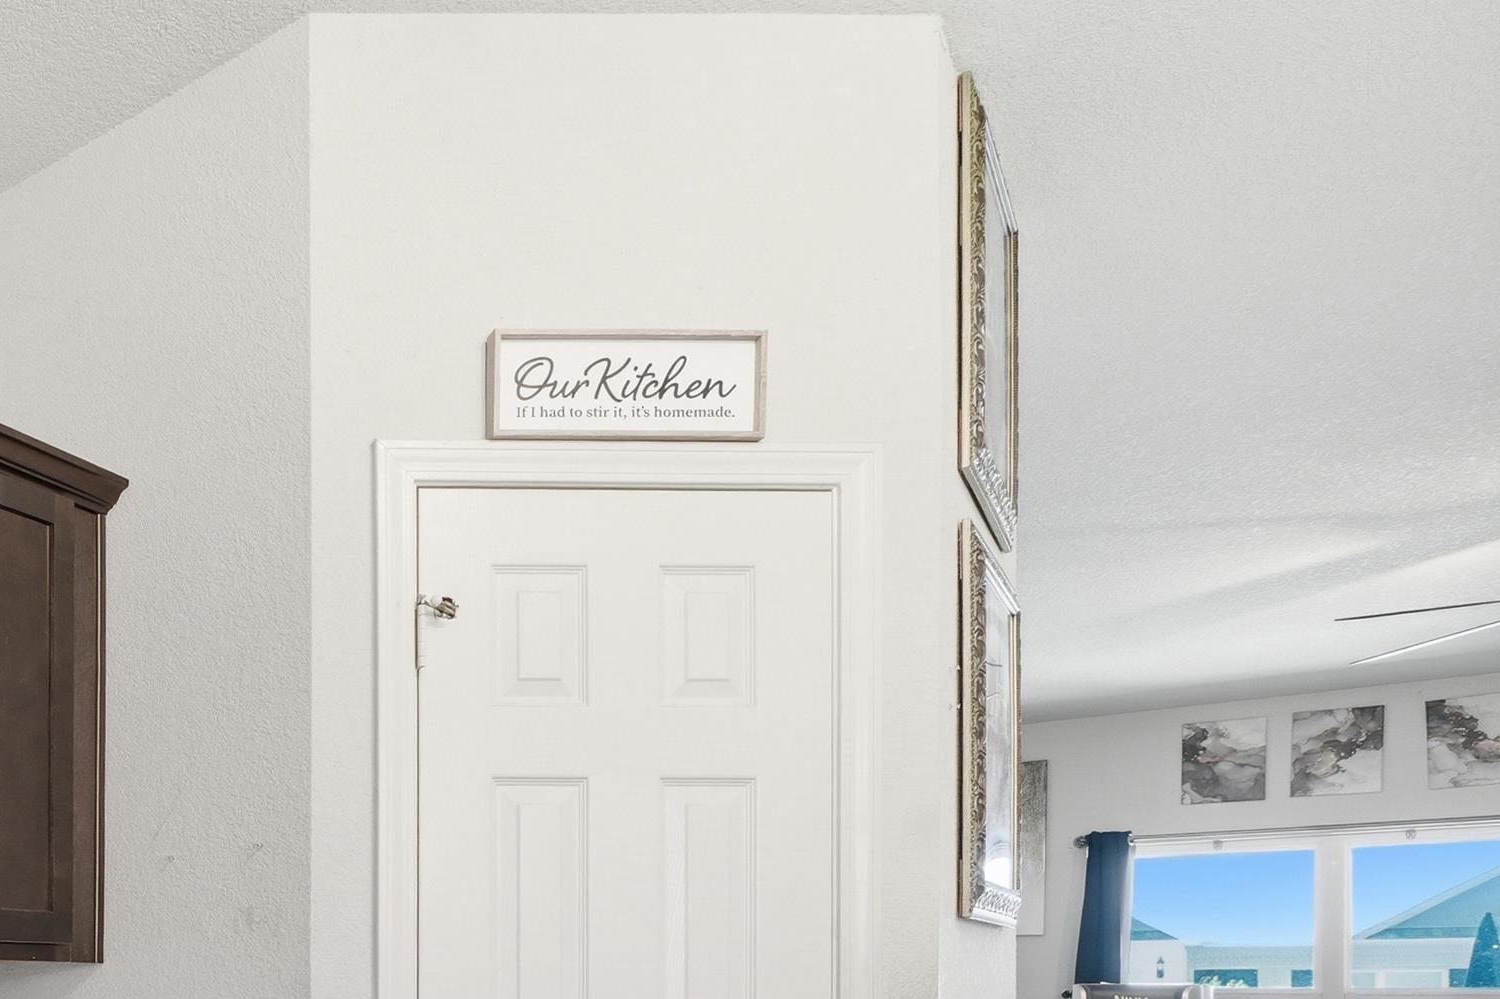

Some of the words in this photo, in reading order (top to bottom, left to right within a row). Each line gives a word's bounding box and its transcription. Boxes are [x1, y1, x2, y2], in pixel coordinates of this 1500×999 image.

[514, 356, 590, 401] Our
[583, 355, 737, 403] Kitchen
[516, 405, 528, 418] If
[531, 406, 536, 418] I
[540, 405, 565, 418] had
[569, 407, 583, 418] to
[586, 405, 610, 418] stir
[613, 405, 627, 420] it,
[631, 405, 650, 418] it's
[654, 405, 736, 418] homemade.
